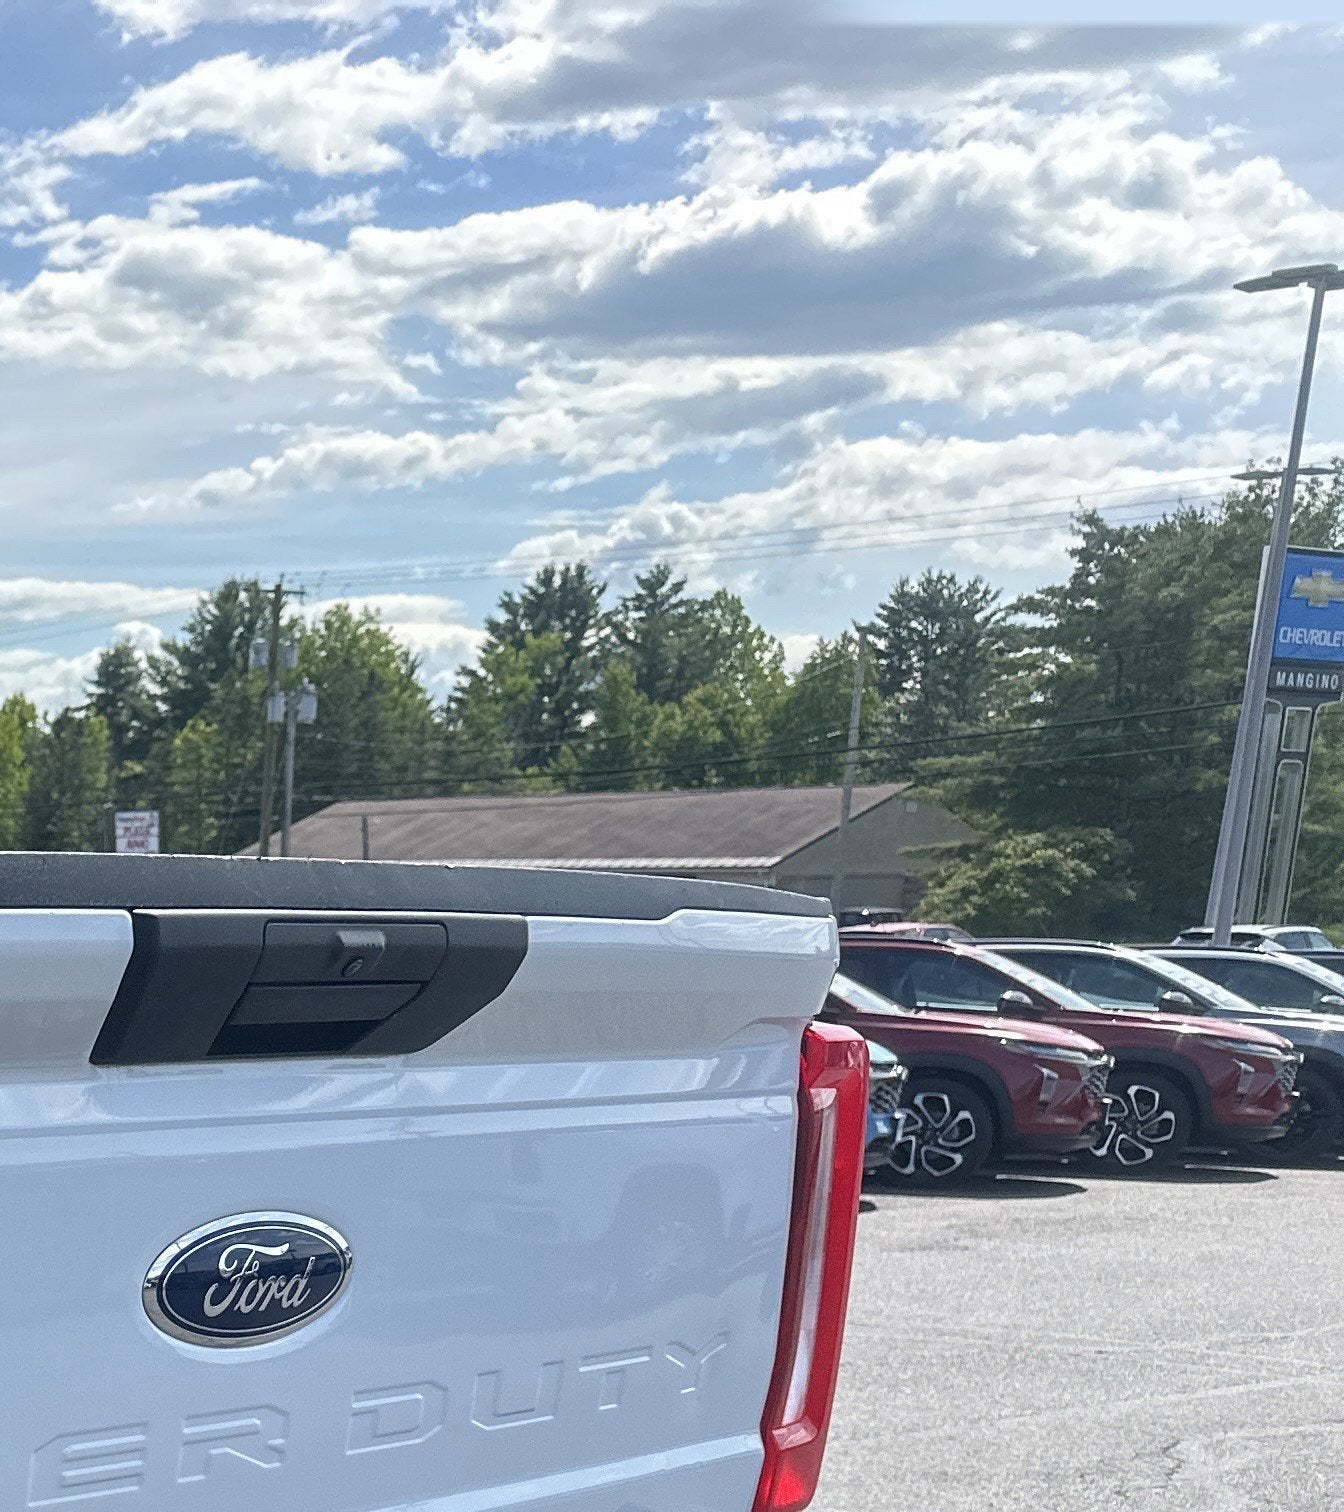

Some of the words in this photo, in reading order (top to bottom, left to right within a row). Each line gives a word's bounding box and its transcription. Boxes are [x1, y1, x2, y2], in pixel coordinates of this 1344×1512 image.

[1276, 671, 1339, 690] MANGINO
[204, 1243, 316, 1317] Ford
[345, 1332, 731, 1455] DUTY
